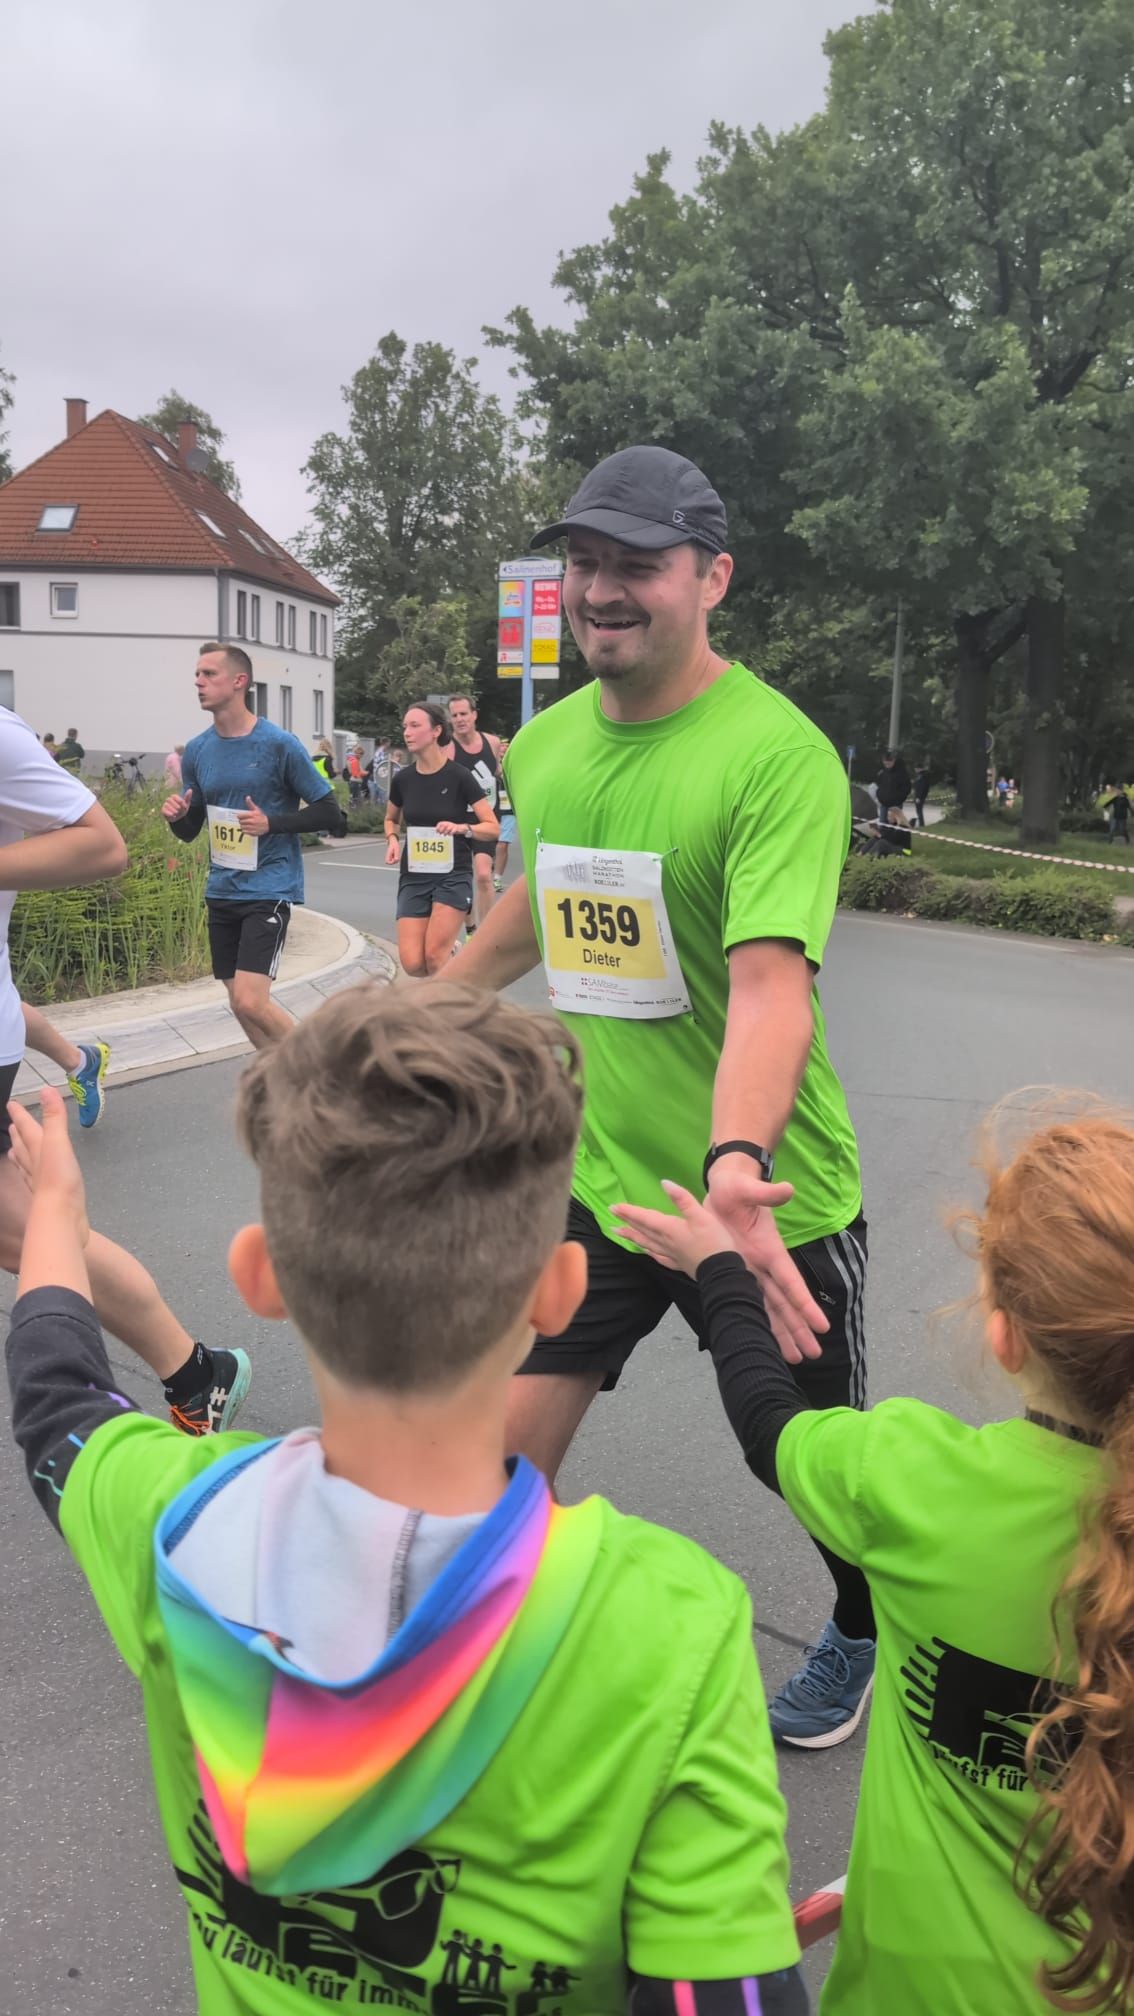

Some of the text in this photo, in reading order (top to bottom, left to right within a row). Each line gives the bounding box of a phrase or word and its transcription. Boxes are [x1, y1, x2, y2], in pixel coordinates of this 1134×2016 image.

[508, 563, 557, 574] Salinenhof
[214, 825, 245, 843] 1617
[415, 841, 444, 853] 1845
[557, 898, 641, 947] 1359
[583, 949, 621, 968] Dieter
[997, 1768, 1029, 1792] für
[306, 1971, 348, 2002] für
